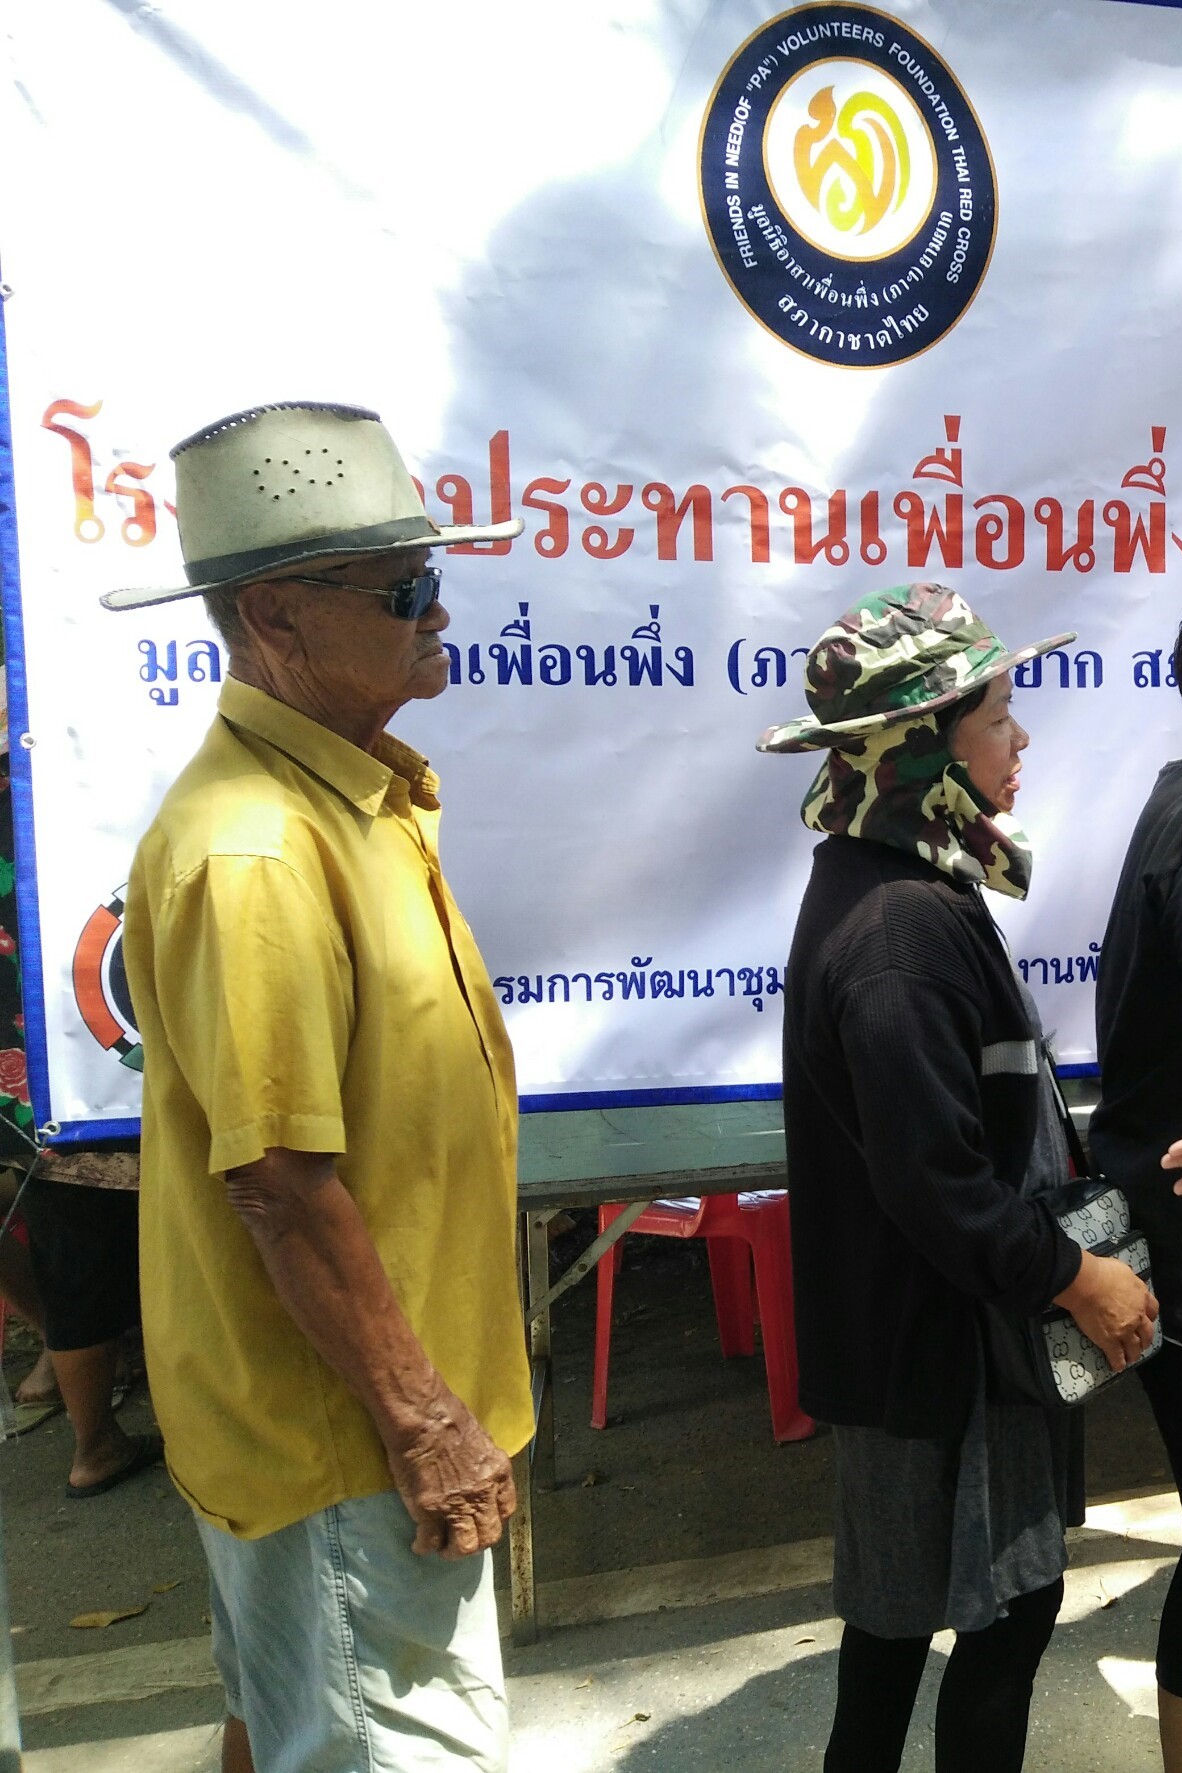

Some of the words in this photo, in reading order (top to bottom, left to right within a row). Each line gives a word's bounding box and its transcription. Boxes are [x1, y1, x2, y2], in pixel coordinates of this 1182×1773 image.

[777, 21, 886, 60] VOLUNTEERS
[888, 43, 960, 141] FOUNDATION
[724, 171, 740, 190] IN
[951, 145, 970, 182] THAI
[958, 188, 974, 222] RED
[727, 195, 758, 269] FRIENDS
[946, 228, 970, 285] CROSS
[777, 293, 931, 351] สภากาชาดไทย
